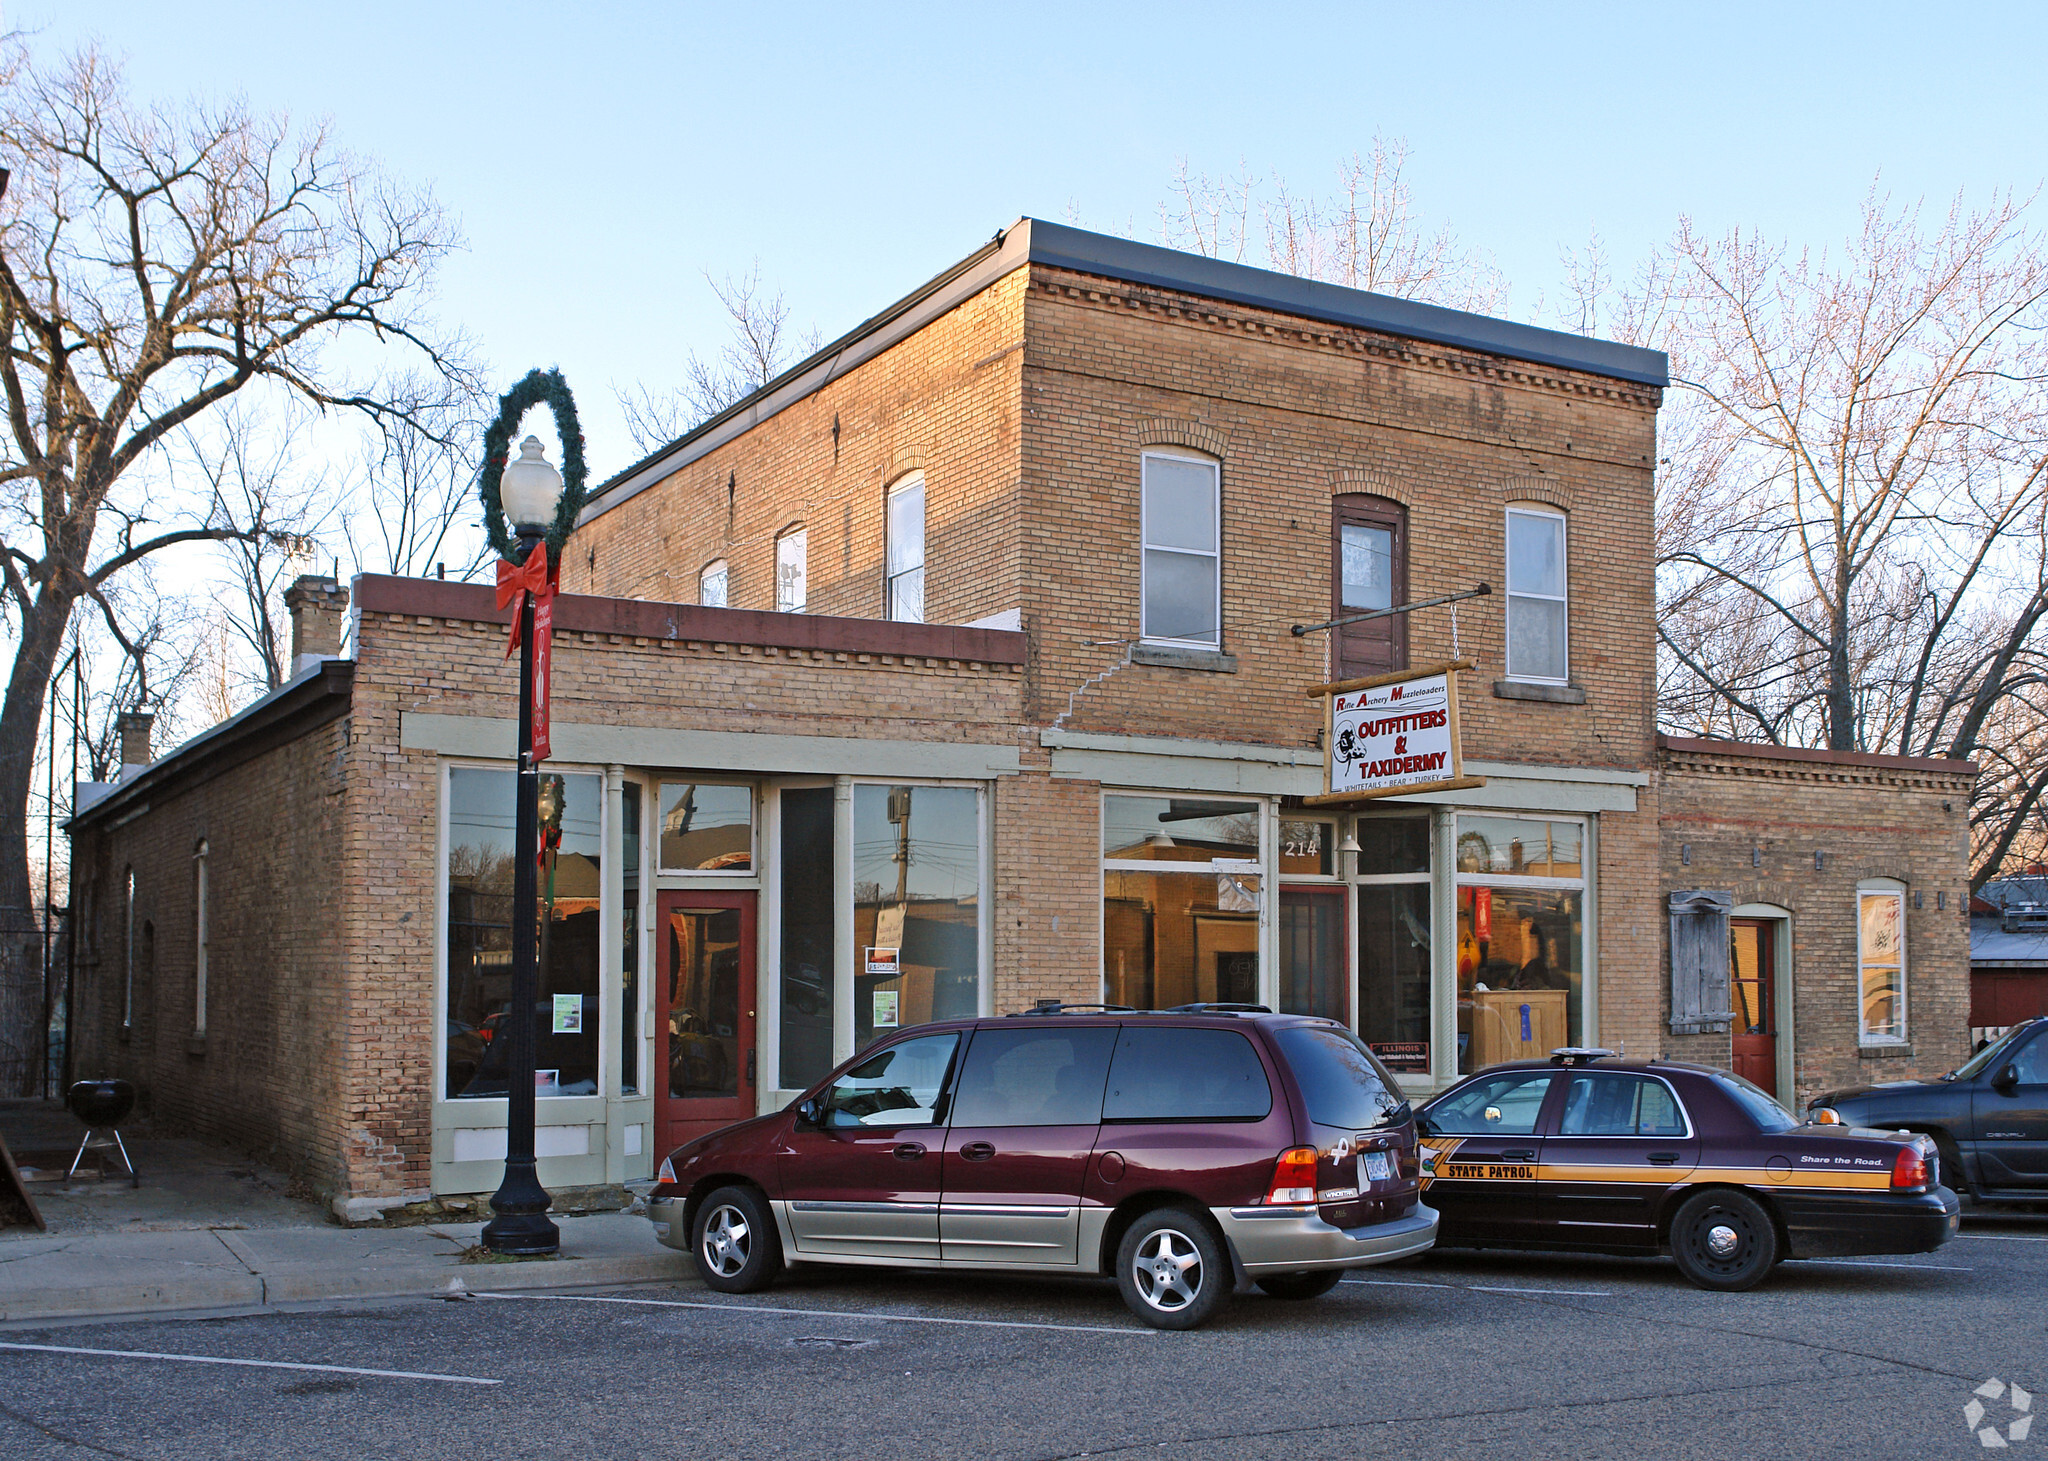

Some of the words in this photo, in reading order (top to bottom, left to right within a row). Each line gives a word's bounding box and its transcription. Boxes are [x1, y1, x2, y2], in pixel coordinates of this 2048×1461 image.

[1336, 697, 1355, 711] Rifle
[1356, 693, 1389, 708] Archery
[1390, 686, 1446, 701] Muzzleloaders
[1358, 709, 1447, 738] OUTFITTERS
[1394, 735, 1408, 755] &
[1359, 751, 1447, 779] TAXIDERMY
[1344, 782, 1382, 792] WHITETAILS
[1389, 778, 1407, 787] BEAR
[1415, 774, 1441, 783] TURKEY
[1285, 840, 1318, 857] 214
[1382, 1045, 1420, 1053] ILLINOIS
[1800, 1155, 1830, 1164] Share
[1854, 1158, 1884, 1166] Road.
[1449, 1165, 1484, 1177] STATE
[1489, 1166, 1533, 1178] PATROL
